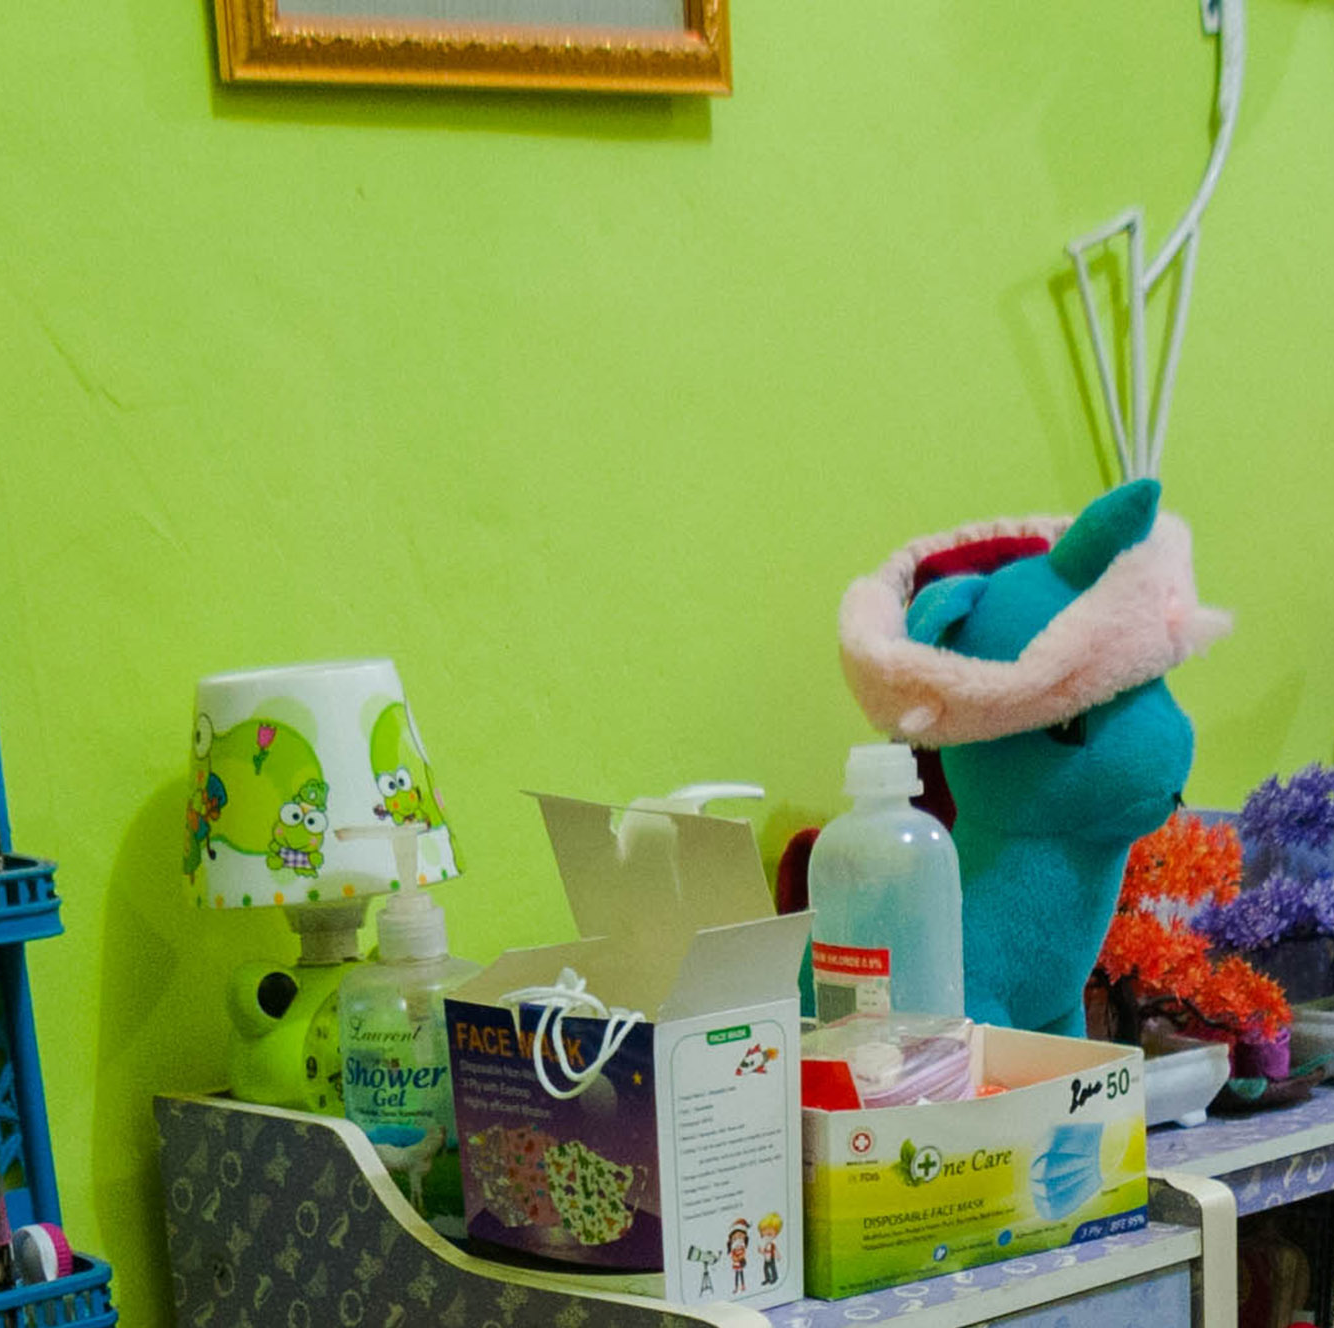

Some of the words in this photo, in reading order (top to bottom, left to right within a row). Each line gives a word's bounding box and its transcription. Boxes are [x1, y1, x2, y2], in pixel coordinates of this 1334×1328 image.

[349, 1015, 422, 1042] Laurent
[455, 1022, 512, 1058] FACE
[518, 1030, 586, 1068] MAK
[345, 1056, 448, 1089] Shower
[1107, 1067, 1130, 1100] 50
[372, 1087, 408, 1108] Gel
[971, 1148, 1013, 1173] Care
[862, 1209, 929, 1230] DISPOSABLE
[930, 1203, 955, 1219] FACE
[956, 1198, 985, 1213] MASK
[1079, 1228, 1088, 1239] 3
[1127, 1213, 1146, 1228] 95%
